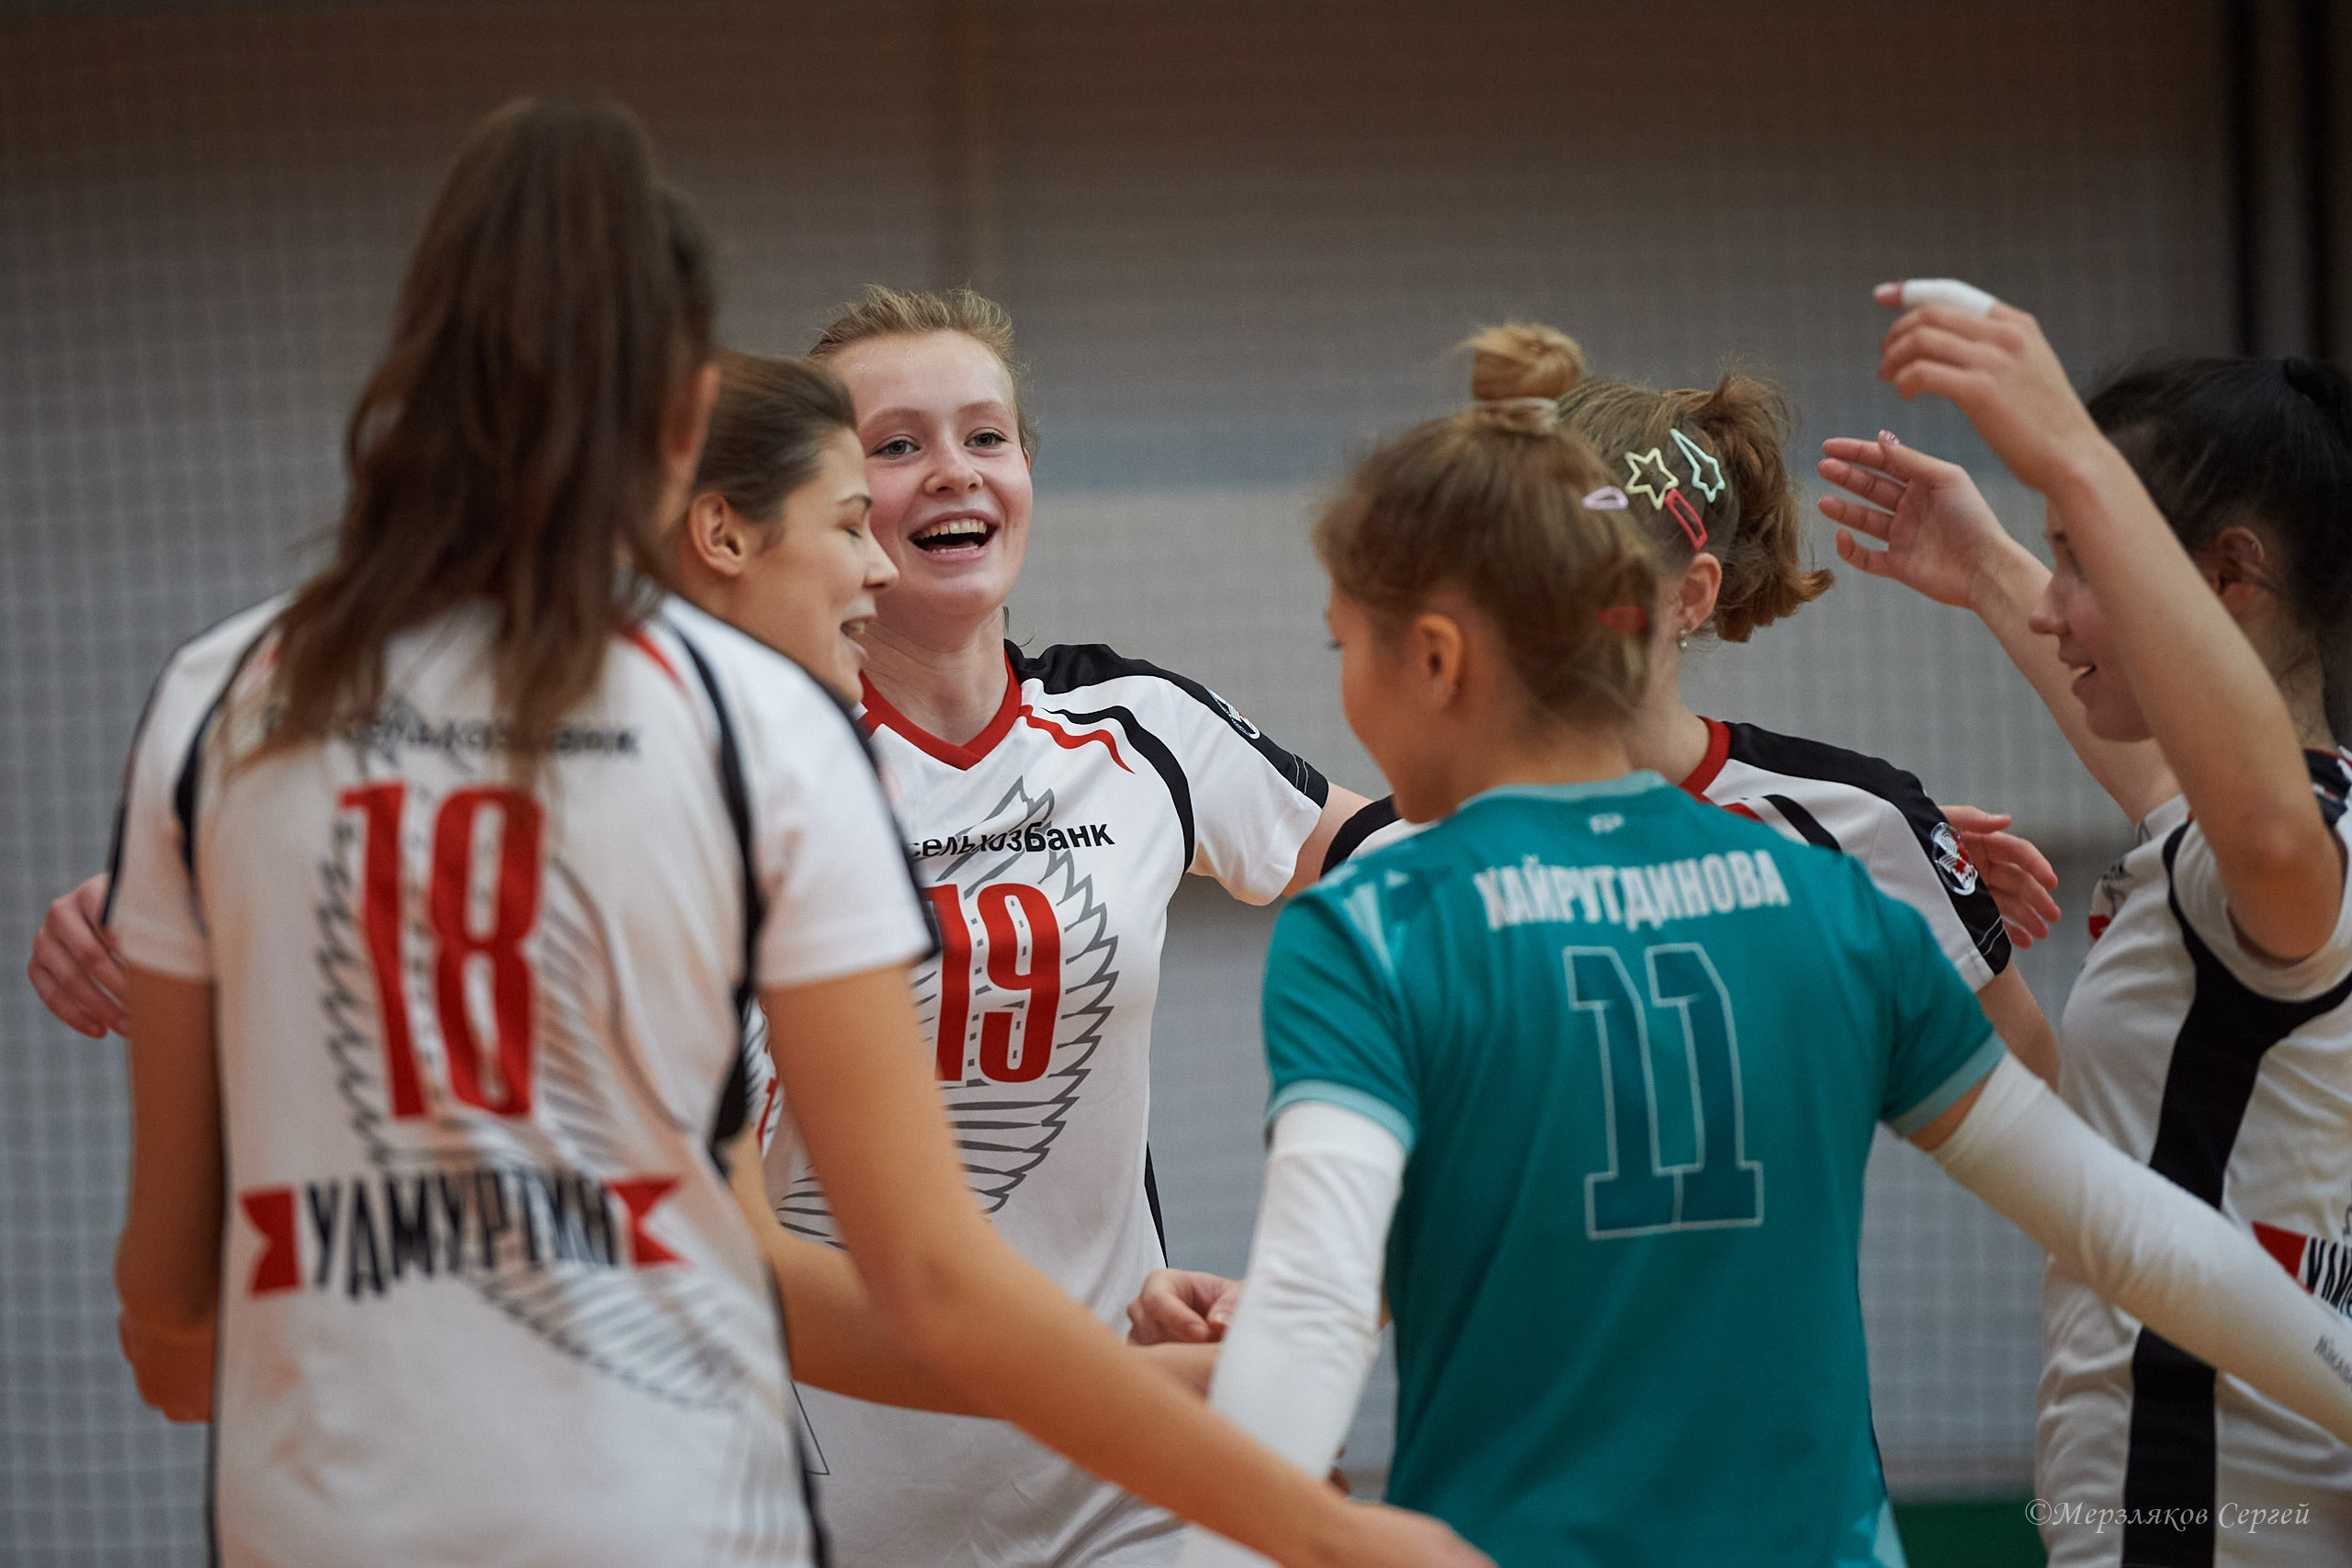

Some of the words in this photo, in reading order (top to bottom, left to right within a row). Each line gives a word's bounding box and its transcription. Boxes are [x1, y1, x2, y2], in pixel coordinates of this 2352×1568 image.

[338, 784, 545, 1120] 18
[922, 882, 1061, 1083] 19
[1474, 850, 1790, 931] ХАЙРУТДИНОВА
[1564, 943, 1763, 1239] 11
